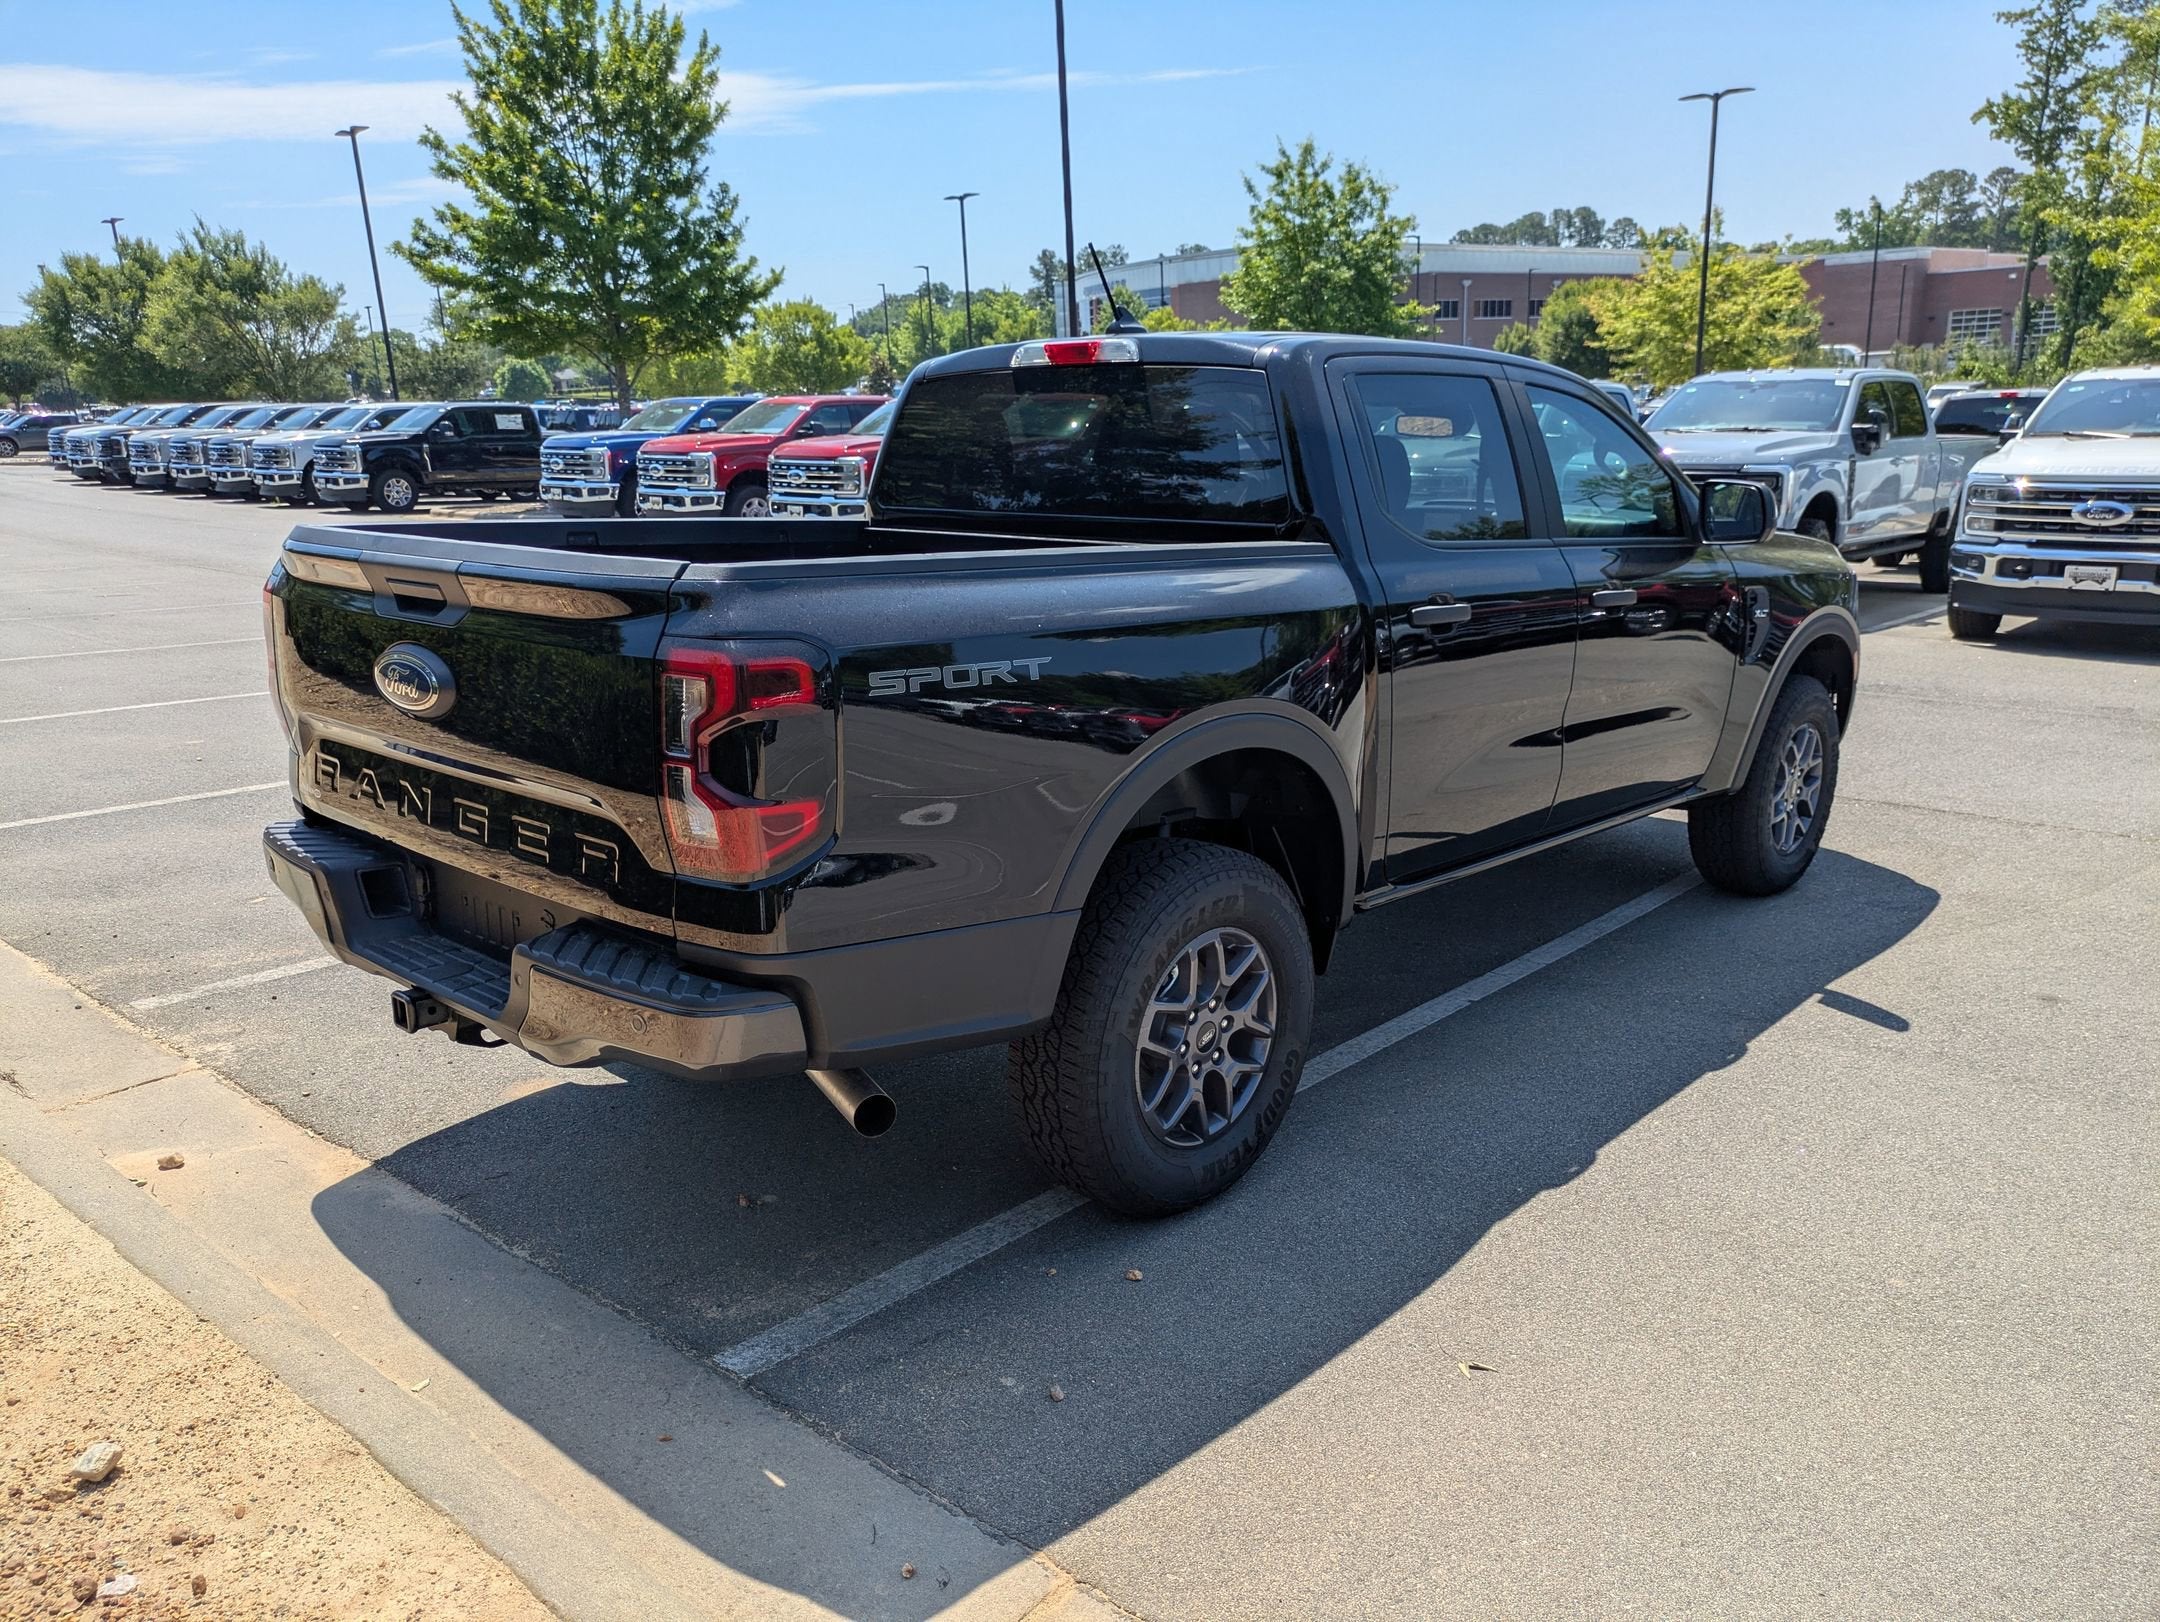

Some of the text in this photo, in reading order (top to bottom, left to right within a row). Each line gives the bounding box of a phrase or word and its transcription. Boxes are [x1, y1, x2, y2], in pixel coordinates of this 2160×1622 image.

[385, 664, 419, 698] Ford
[868, 656, 1053, 697] SPORT
[314, 751, 620, 885] RANGER
[1200, 1048, 1300, 1185] GOODYEAR
